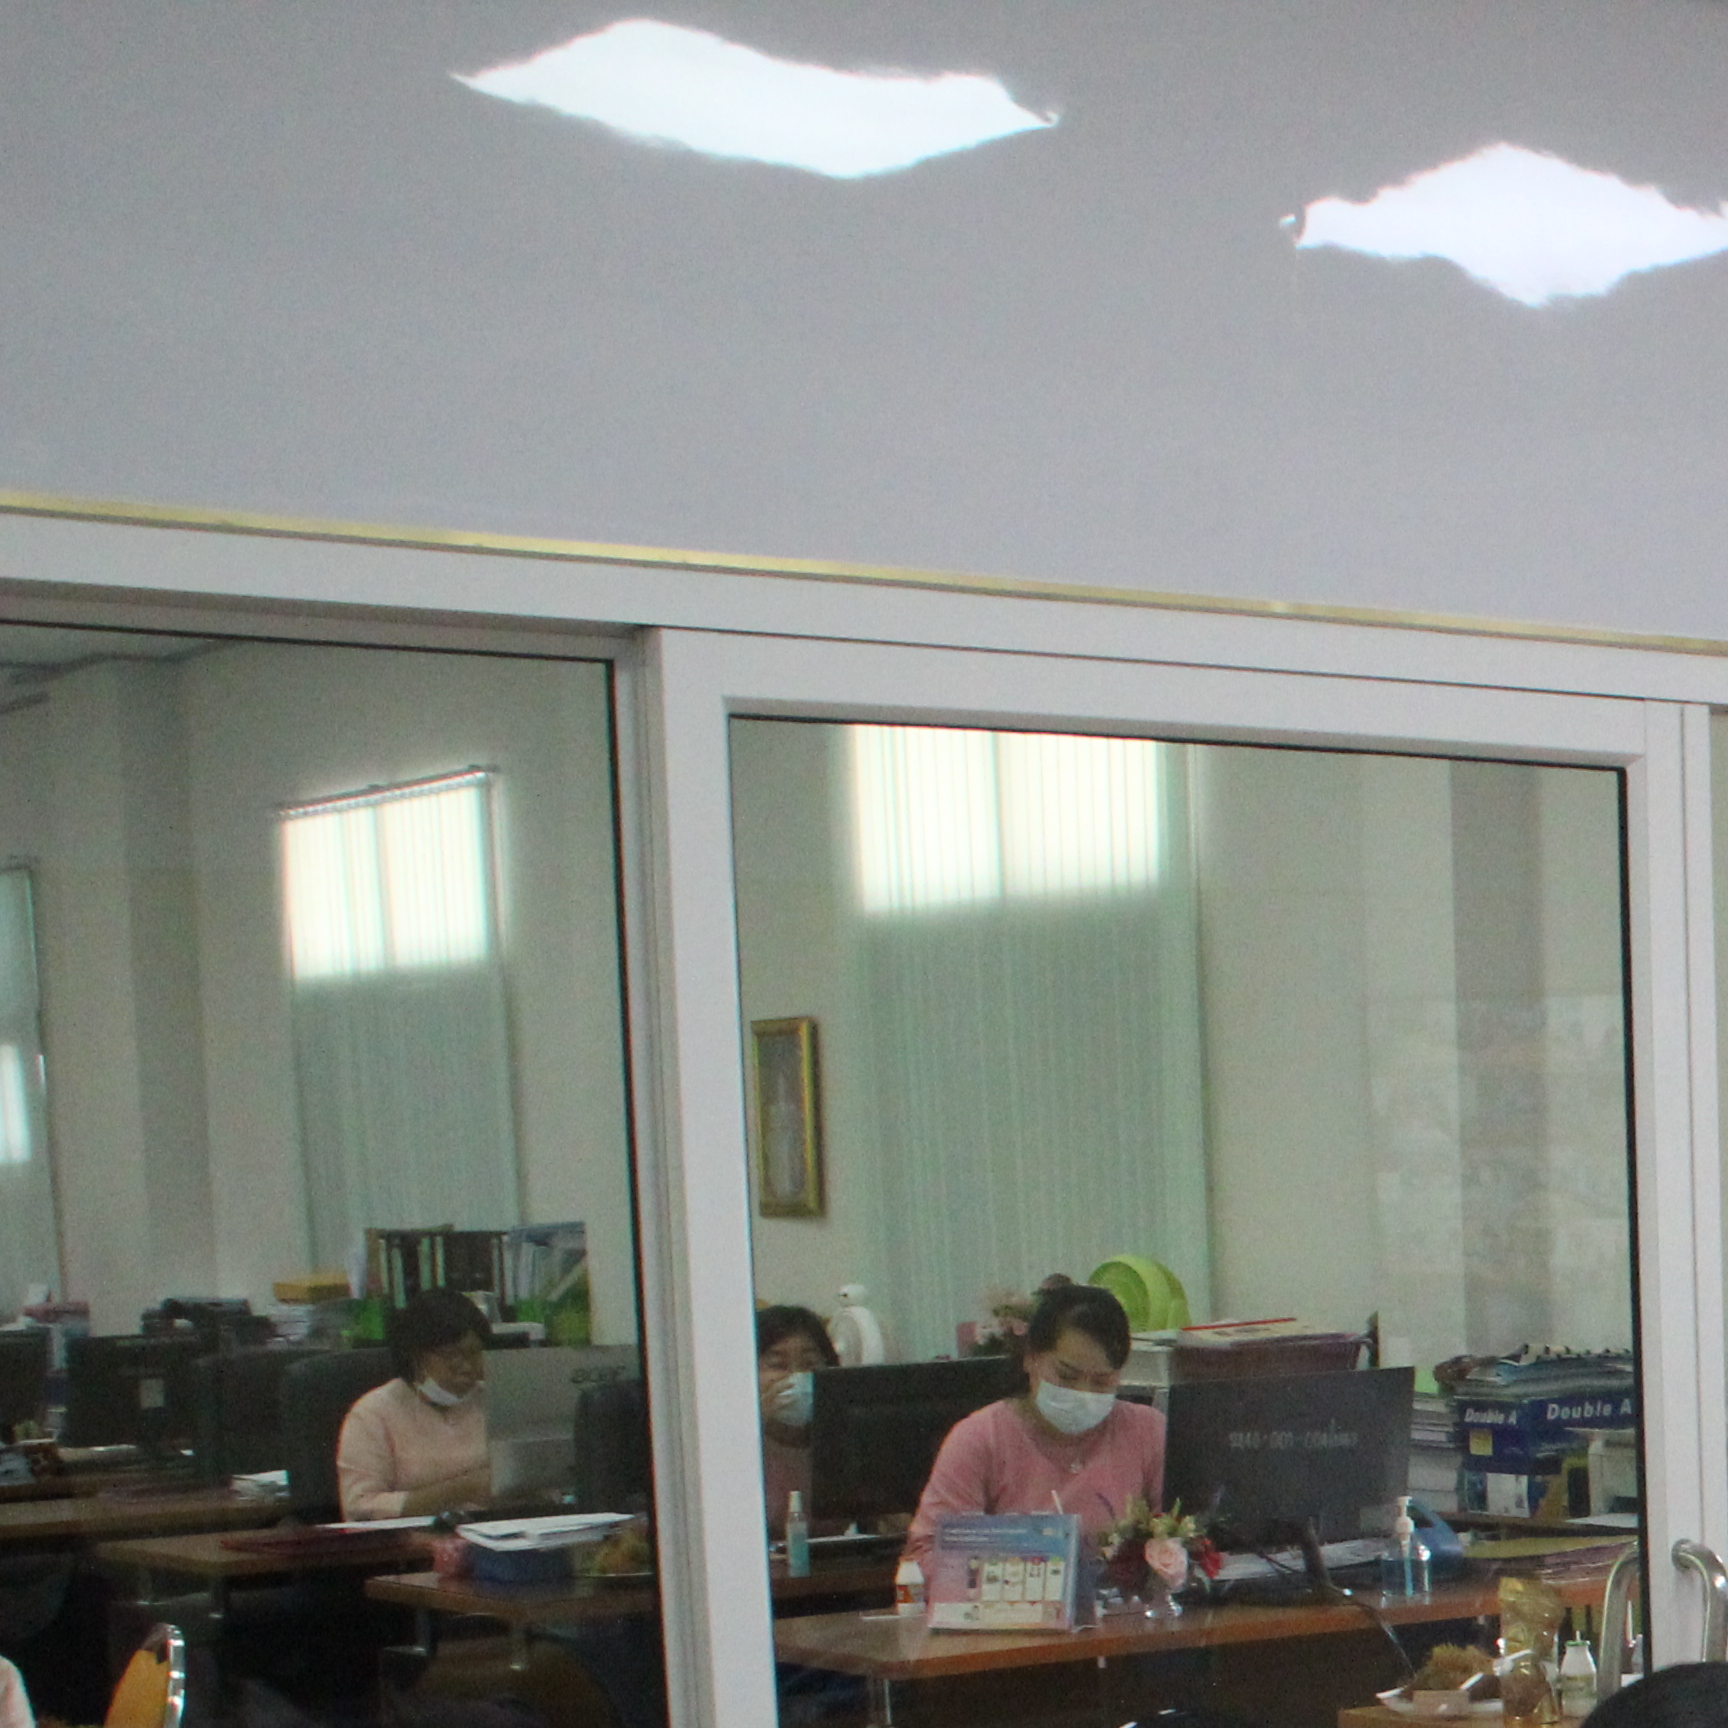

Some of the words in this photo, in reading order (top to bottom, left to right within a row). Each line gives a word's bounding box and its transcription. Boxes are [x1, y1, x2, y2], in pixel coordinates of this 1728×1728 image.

[1464, 1408, 1506, 1424] Double
[1546, 1400, 1613, 1420] Double
[1619, 1398, 1632, 1415] A
